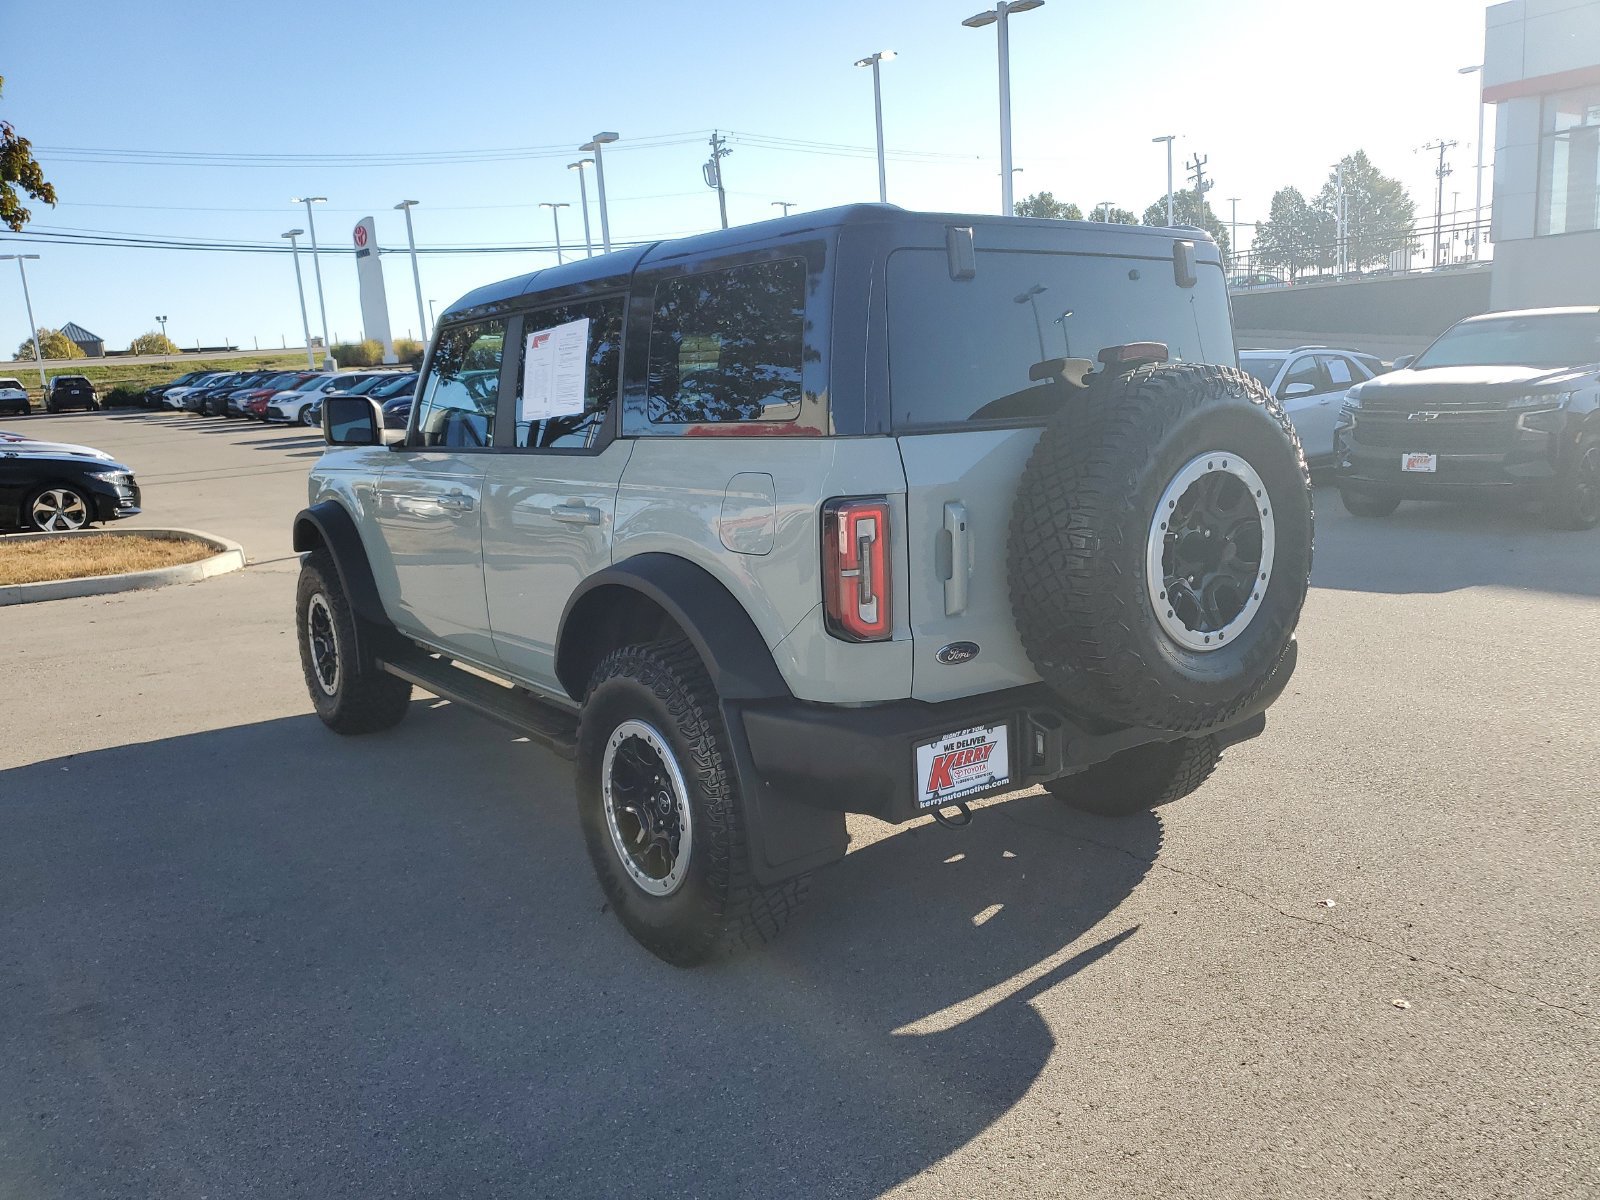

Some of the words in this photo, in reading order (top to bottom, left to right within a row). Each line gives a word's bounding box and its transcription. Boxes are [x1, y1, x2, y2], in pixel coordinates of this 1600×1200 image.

[947, 647, 971, 661] Ford
[944, 743, 954, 752] WE
[956, 735, 986, 749] DELIVER
[927, 741, 996, 793] KERRY
[964, 764, 986, 775] TOYOTA
[920, 778, 1009, 809] kerryautomotive.com
